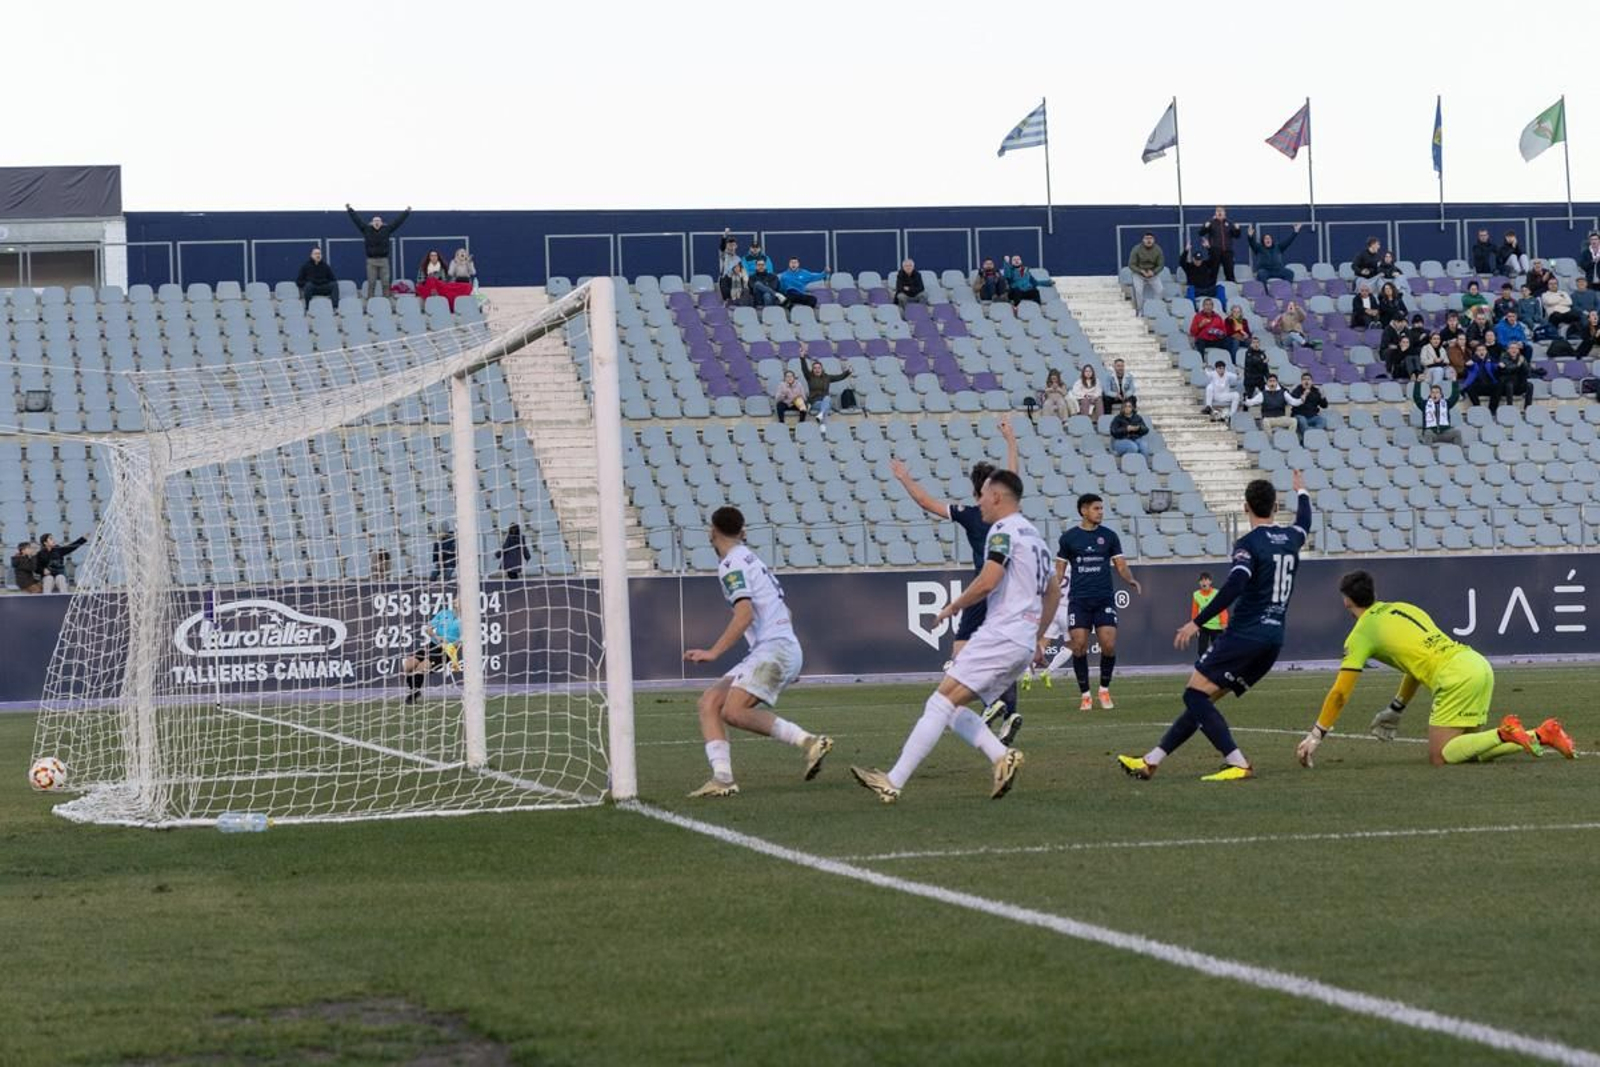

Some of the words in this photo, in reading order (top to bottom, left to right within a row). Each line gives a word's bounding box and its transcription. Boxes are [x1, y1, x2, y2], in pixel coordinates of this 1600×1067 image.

[1271, 554, 1295, 606] 16
[374, 594, 412, 617] 953
[1390, 608, 1429, 633] 1
[375, 625, 413, 648] 625
[172, 663, 269, 684] TALLERES
[274, 657, 355, 681] CÁMARA
